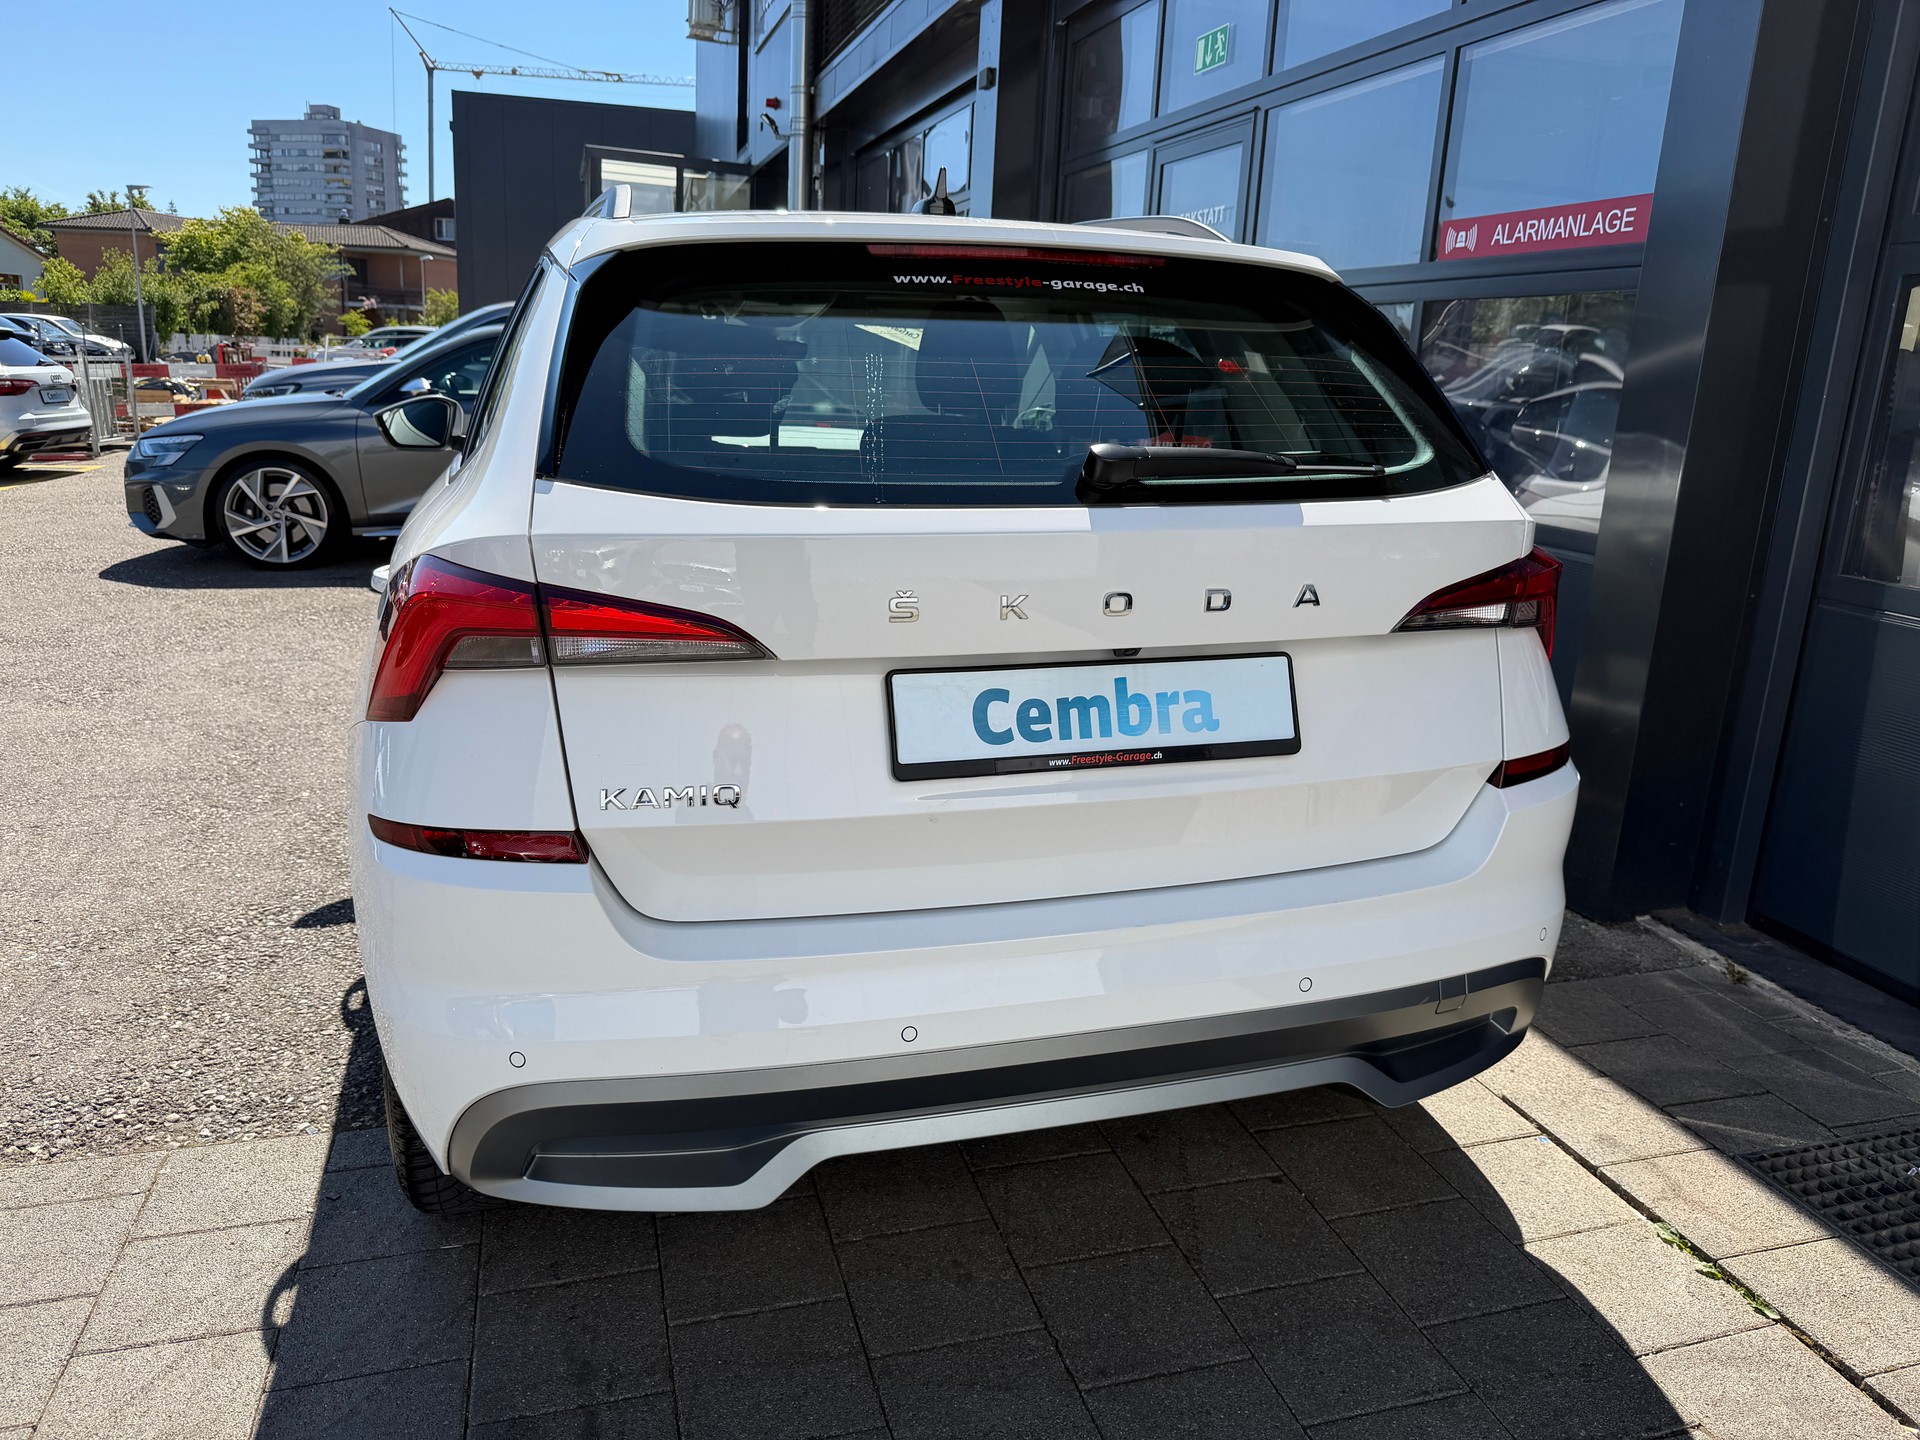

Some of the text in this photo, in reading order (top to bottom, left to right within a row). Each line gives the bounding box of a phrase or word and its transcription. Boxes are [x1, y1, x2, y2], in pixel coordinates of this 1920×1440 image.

[1490, 207, 1637, 246] ALARMANLAGE
[893, 274, 1145, 293] www.Freestyle-garage.ch
[888, 583, 1321, 624] ŠKODA
[972, 676, 1220, 746] Cembra
[1048, 751, 1163, 767] www.Freestyle-Garage.ch
[599, 783, 742, 811] KAMIQ
